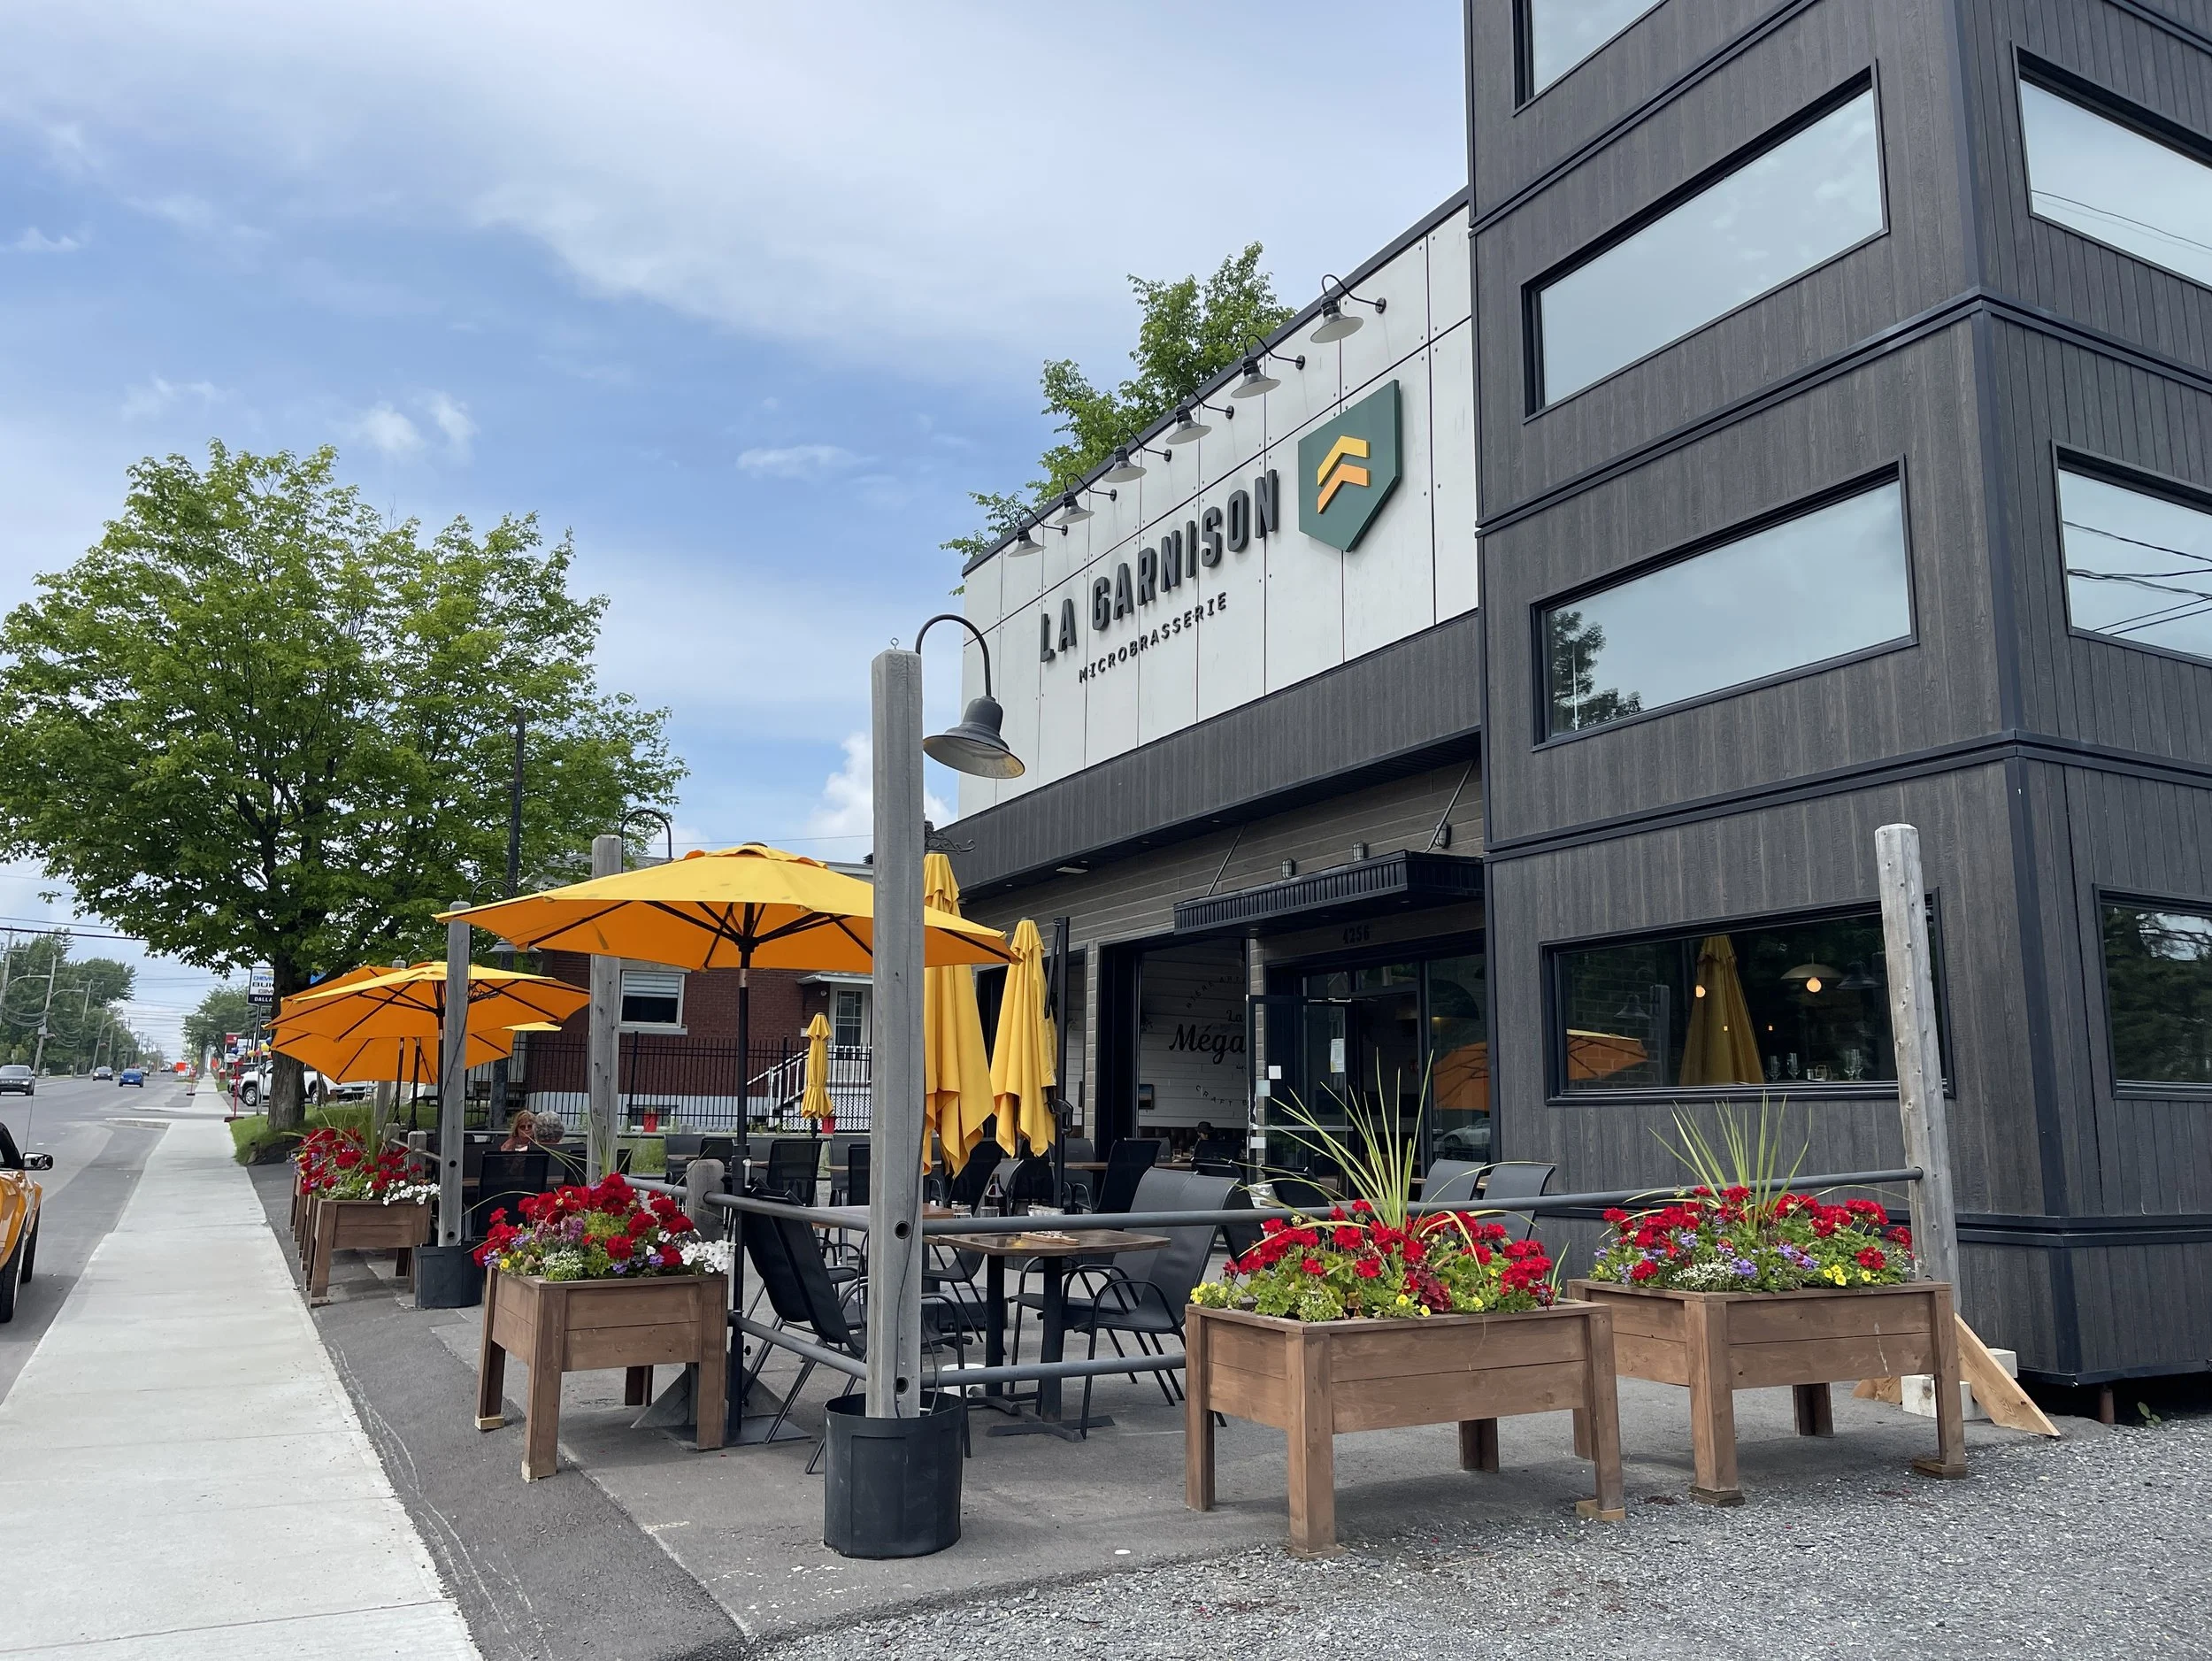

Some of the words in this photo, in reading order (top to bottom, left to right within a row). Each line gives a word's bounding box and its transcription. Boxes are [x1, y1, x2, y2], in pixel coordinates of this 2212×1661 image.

[1041, 598, 1077, 663] LA
[1092, 469, 1279, 631] GARNISON
[1079, 591, 1227, 684] MICROBRASSERIE
[1342, 925, 1371, 945] 4256
[1169, 1024, 1246, 1065] Méga
